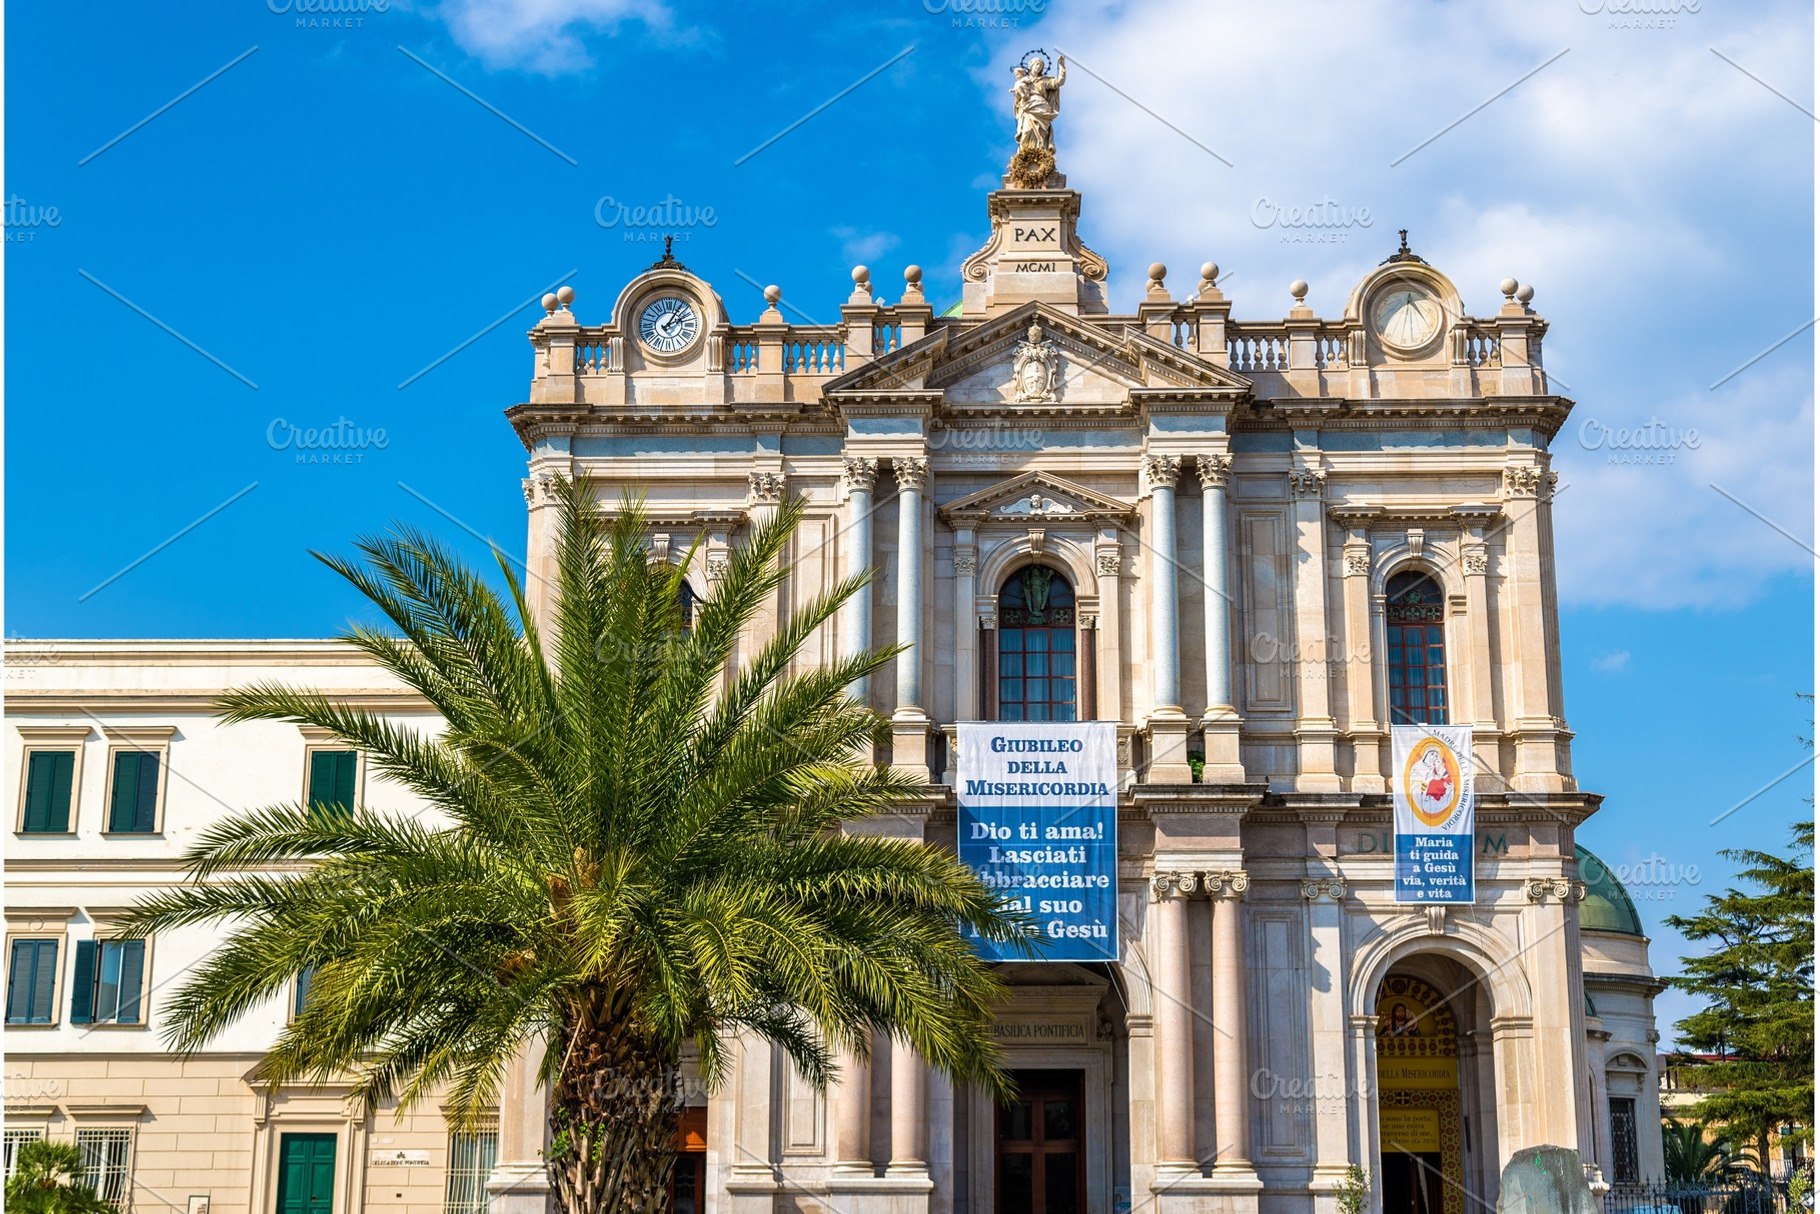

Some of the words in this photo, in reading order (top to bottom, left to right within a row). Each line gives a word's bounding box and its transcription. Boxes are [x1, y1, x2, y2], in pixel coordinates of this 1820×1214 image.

[1014, 228, 1056, 242] PAX
[1015, 262, 1056, 272] MCMI
[1007, 761, 1068, 774] DELLA
[971, 822, 1012, 839] Dio
[1019, 822, 1039, 839] ti
[1045, 822, 1104, 839] ama!
[1415, 837, 1454, 847] Maria
[989, 846, 1087, 863] Lasciati
[1410, 850, 1420, 860] ti
[1423, 850, 1459, 862] guida
[1424, 862, 1456, 872] Gesù
[974, 871, 1110, 888] bbracciare
[1402, 876, 1425, 886] via,
[1429, 875, 1467, 885] verità
[1428, 888, 1452, 898] vita
[1039, 899, 1083, 913] suo
[1047, 919, 1108, 938] Gesù
[993, 1025, 1031, 1037] BASILICA
[1034, 1025, 1085, 1037] PONTIFICIA
